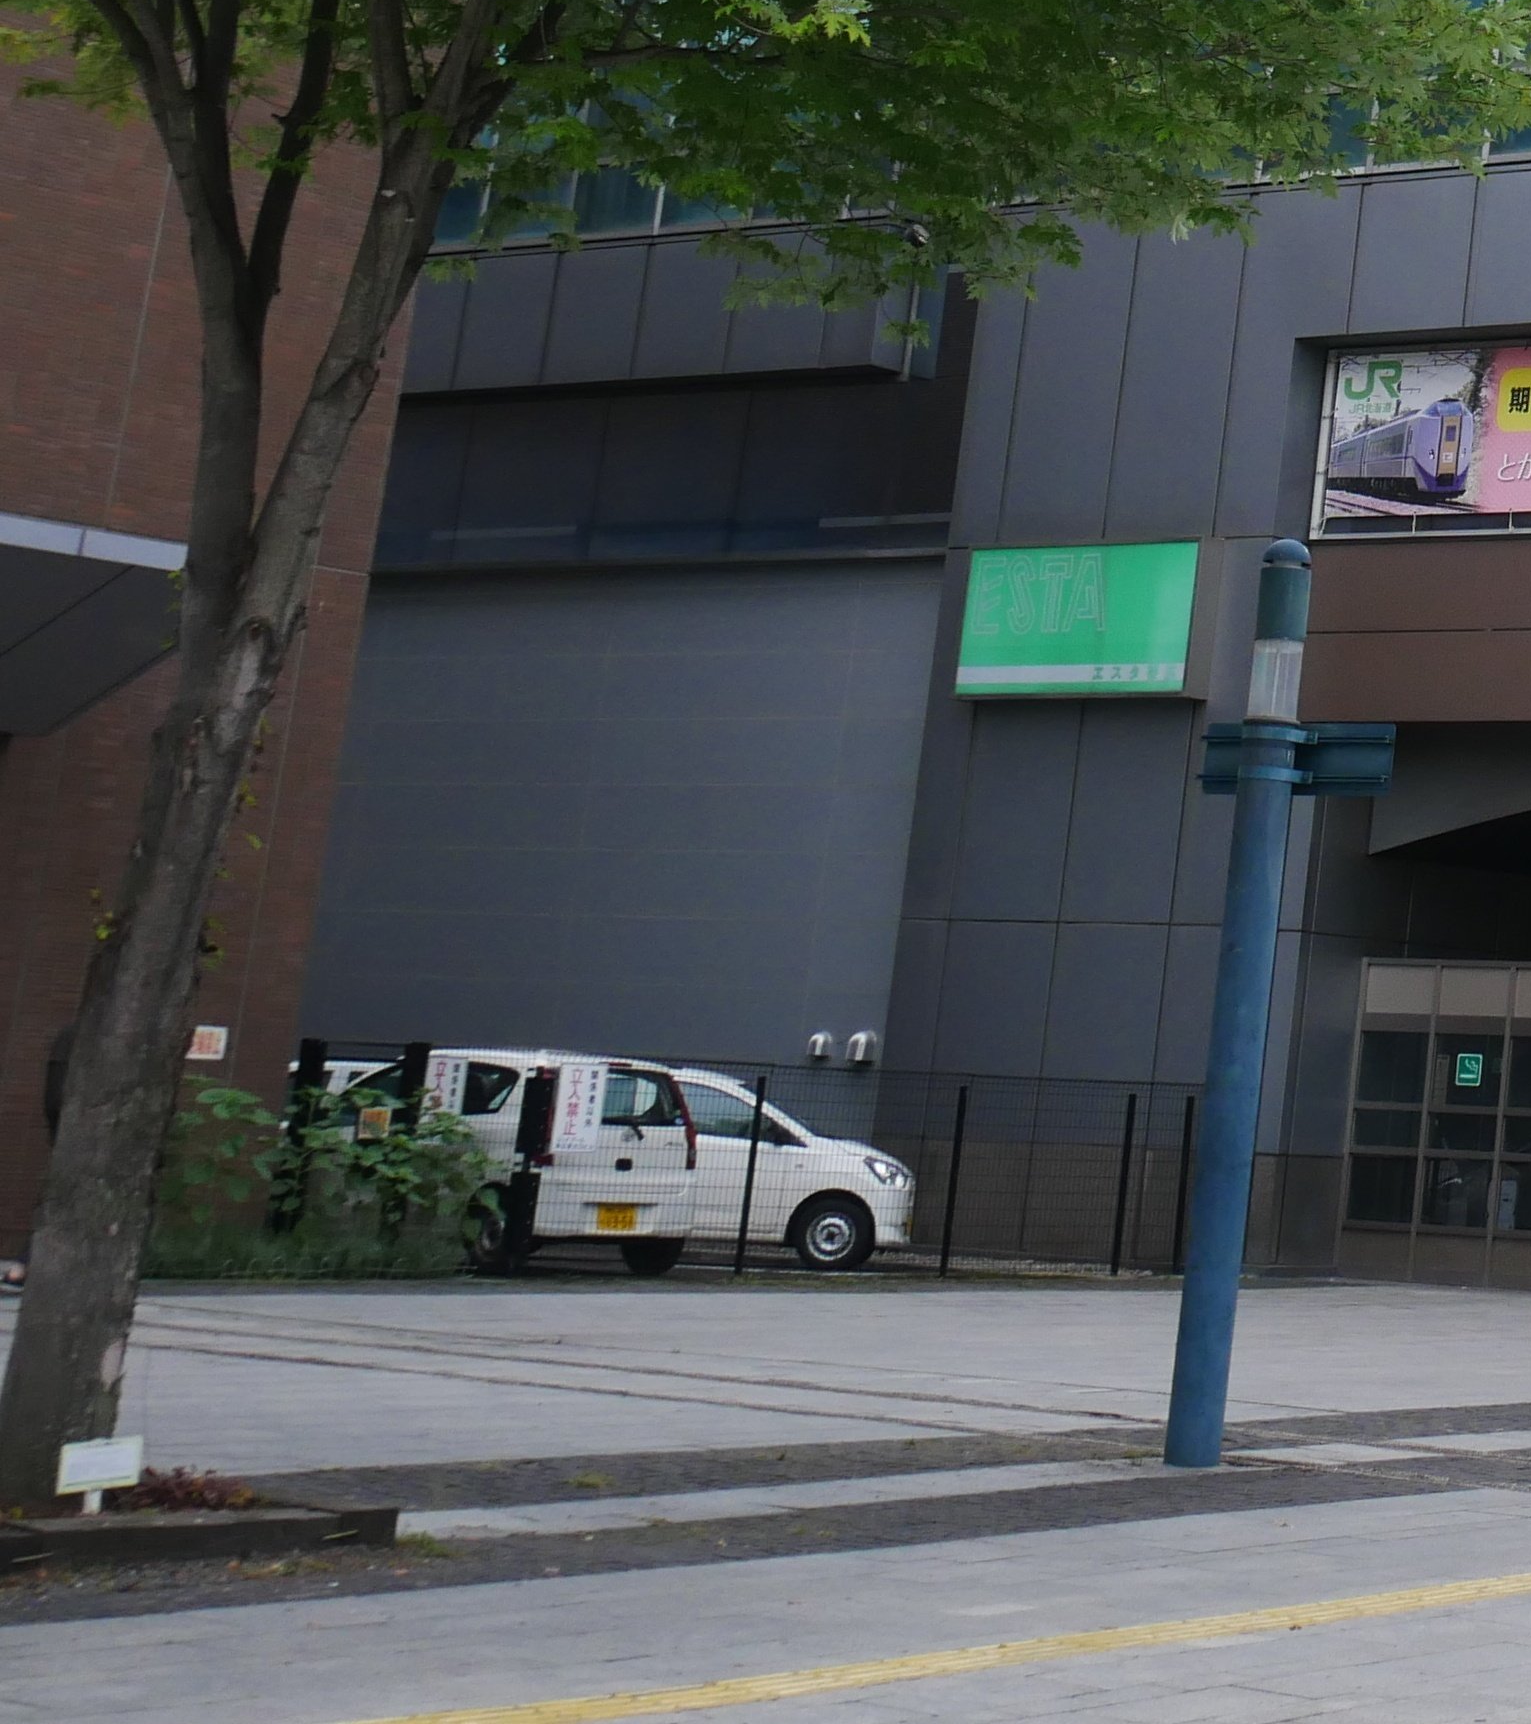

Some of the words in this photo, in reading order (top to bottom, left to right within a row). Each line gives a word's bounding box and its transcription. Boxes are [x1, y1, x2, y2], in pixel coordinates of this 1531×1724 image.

[1343, 359, 1403, 401] JR
[971, 553, 1106, 636] ESTA
[563, 1068, 584, 1136] 立入禁止
